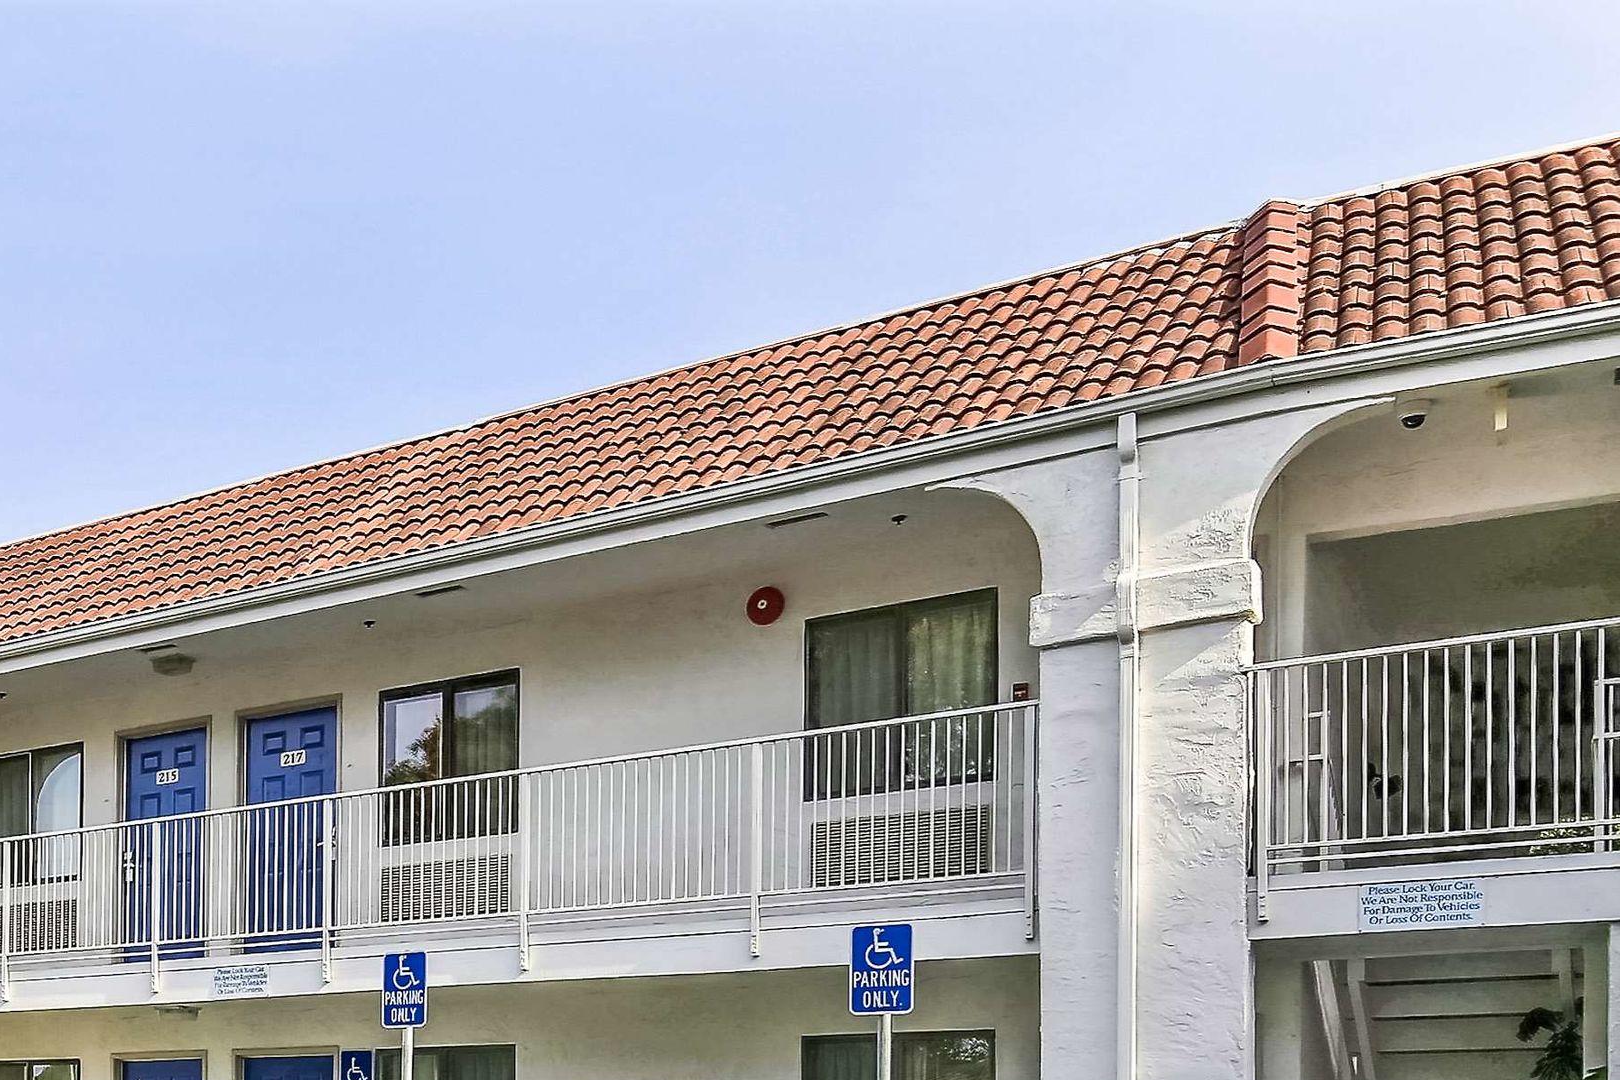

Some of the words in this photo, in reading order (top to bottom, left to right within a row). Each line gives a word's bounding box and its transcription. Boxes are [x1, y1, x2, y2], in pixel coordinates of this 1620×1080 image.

[283, 751, 304, 765] 217
[158, 770, 177, 783] 215
[1368, 886, 1400, 895] Please
[1402, 884, 1427, 893] Lock
[1428, 882, 1452, 892] Your
[1361, 896, 1378, 905] We
[1379, 895, 1397, 905] Are
[1399, 894, 1418, 904] Not
[1420, 890, 1483, 904] Responsible
[1363, 906, 1380, 915] For
[1381, 904, 1423, 915] Damage
[1424, 903, 1436, 912] To
[1437, 901, 1481, 911] Vehicles
[1369, 916, 1384, 925] Or
[1385, 915, 1408, 924] Loss
[1409, 913, 1423, 923] Of
[853, 969, 910, 988] PARKING
[384, 989, 424, 1006] PARKING
[390, 1007, 417, 1023] ONLY
